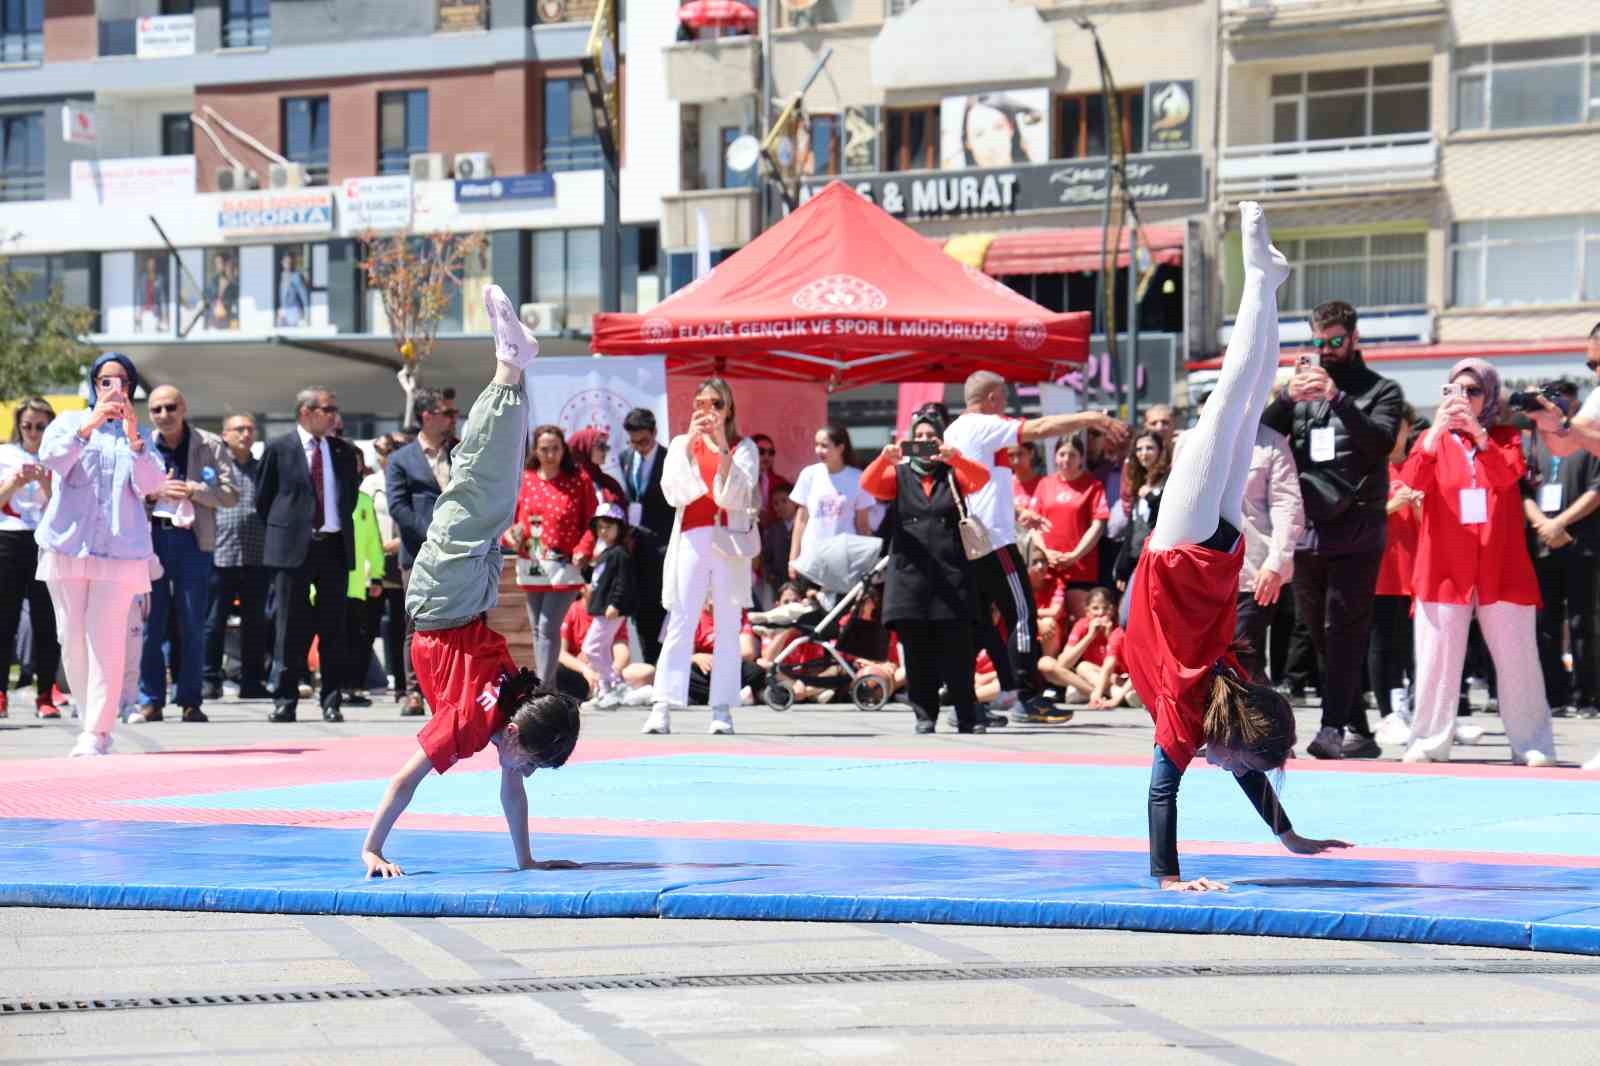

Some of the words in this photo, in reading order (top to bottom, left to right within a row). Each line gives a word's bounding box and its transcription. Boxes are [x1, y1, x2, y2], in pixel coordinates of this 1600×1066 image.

[882, 181, 904, 214] &
[912, 174, 1016, 213] MURAT
[738, 316, 807, 339] GENÇLİK
[810, 319, 832, 335] VE
[836, 319, 878, 336] SPOR
[883, 316, 896, 337] İL
